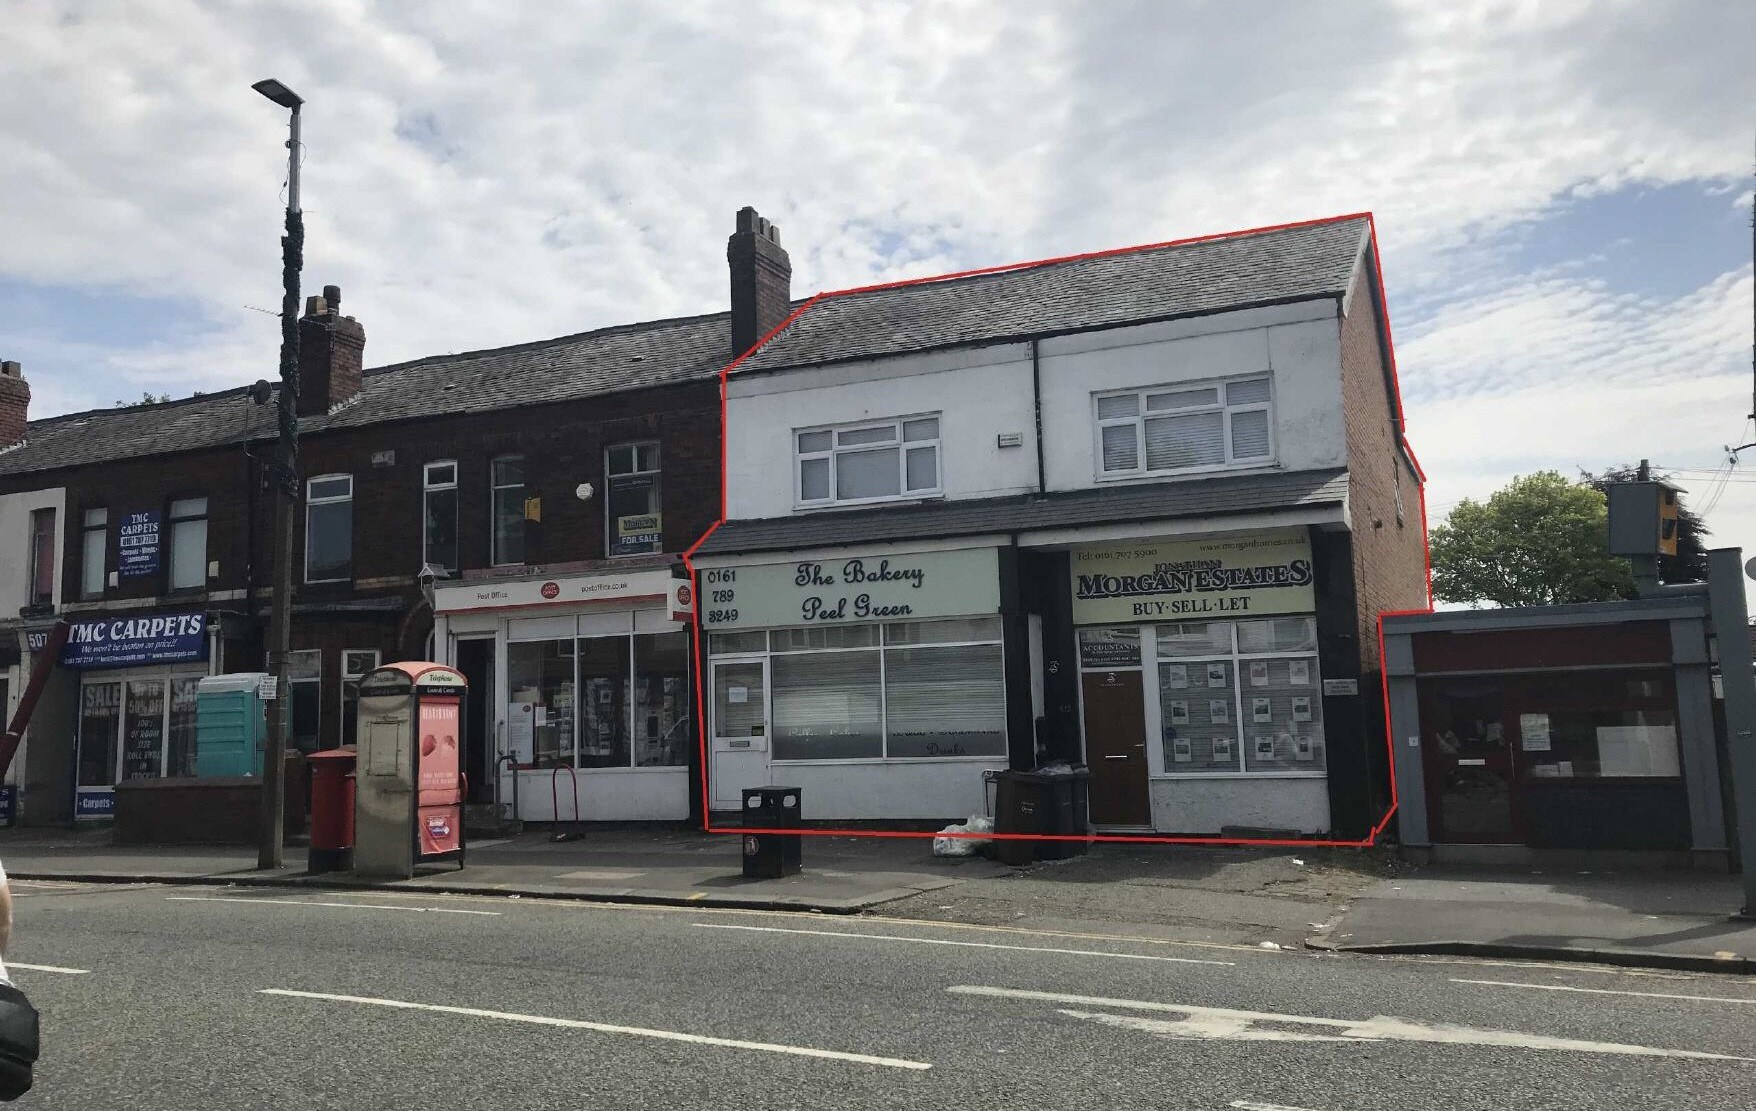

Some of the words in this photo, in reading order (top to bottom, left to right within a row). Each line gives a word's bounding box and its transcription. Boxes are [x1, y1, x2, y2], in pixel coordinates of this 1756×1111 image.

[131, 513, 149, 523] TMC
[121, 522, 159, 535] CARPETS
[621, 536, 637, 545] FOR
[639, 534, 659, 543] SALE
[1077, 551, 1093, 561] Tel:
[1095, 552, 1114, 560] 0161
[1134, 548, 1158, 559] 5900
[708, 569, 736, 583] 0161
[795, 562, 835, 588] The
[843, 560, 925, 589] Bakery
[1076, 570, 1192, 599] MORGAN
[1193, 560, 1313, 592] ESTATES
[581, 583, 628, 593] postoffice.co.uk
[477, 592, 490, 600] Post
[491, 591, 508, 599] Office
[712, 589, 735, 603] 789
[802, 598, 846, 621] Peel
[854, 593, 913, 618] Green
[1219, 597, 1251, 611] LET
[708, 607, 739, 624] 3249
[66, 622, 106, 643] TMC
[110, 615, 202, 641] CARPETS
[28, 633, 48, 648] 507
[81, 645, 92, 654] We
[85, 685, 121, 708] SALE
[83, 798, 110, 809] Carpets
